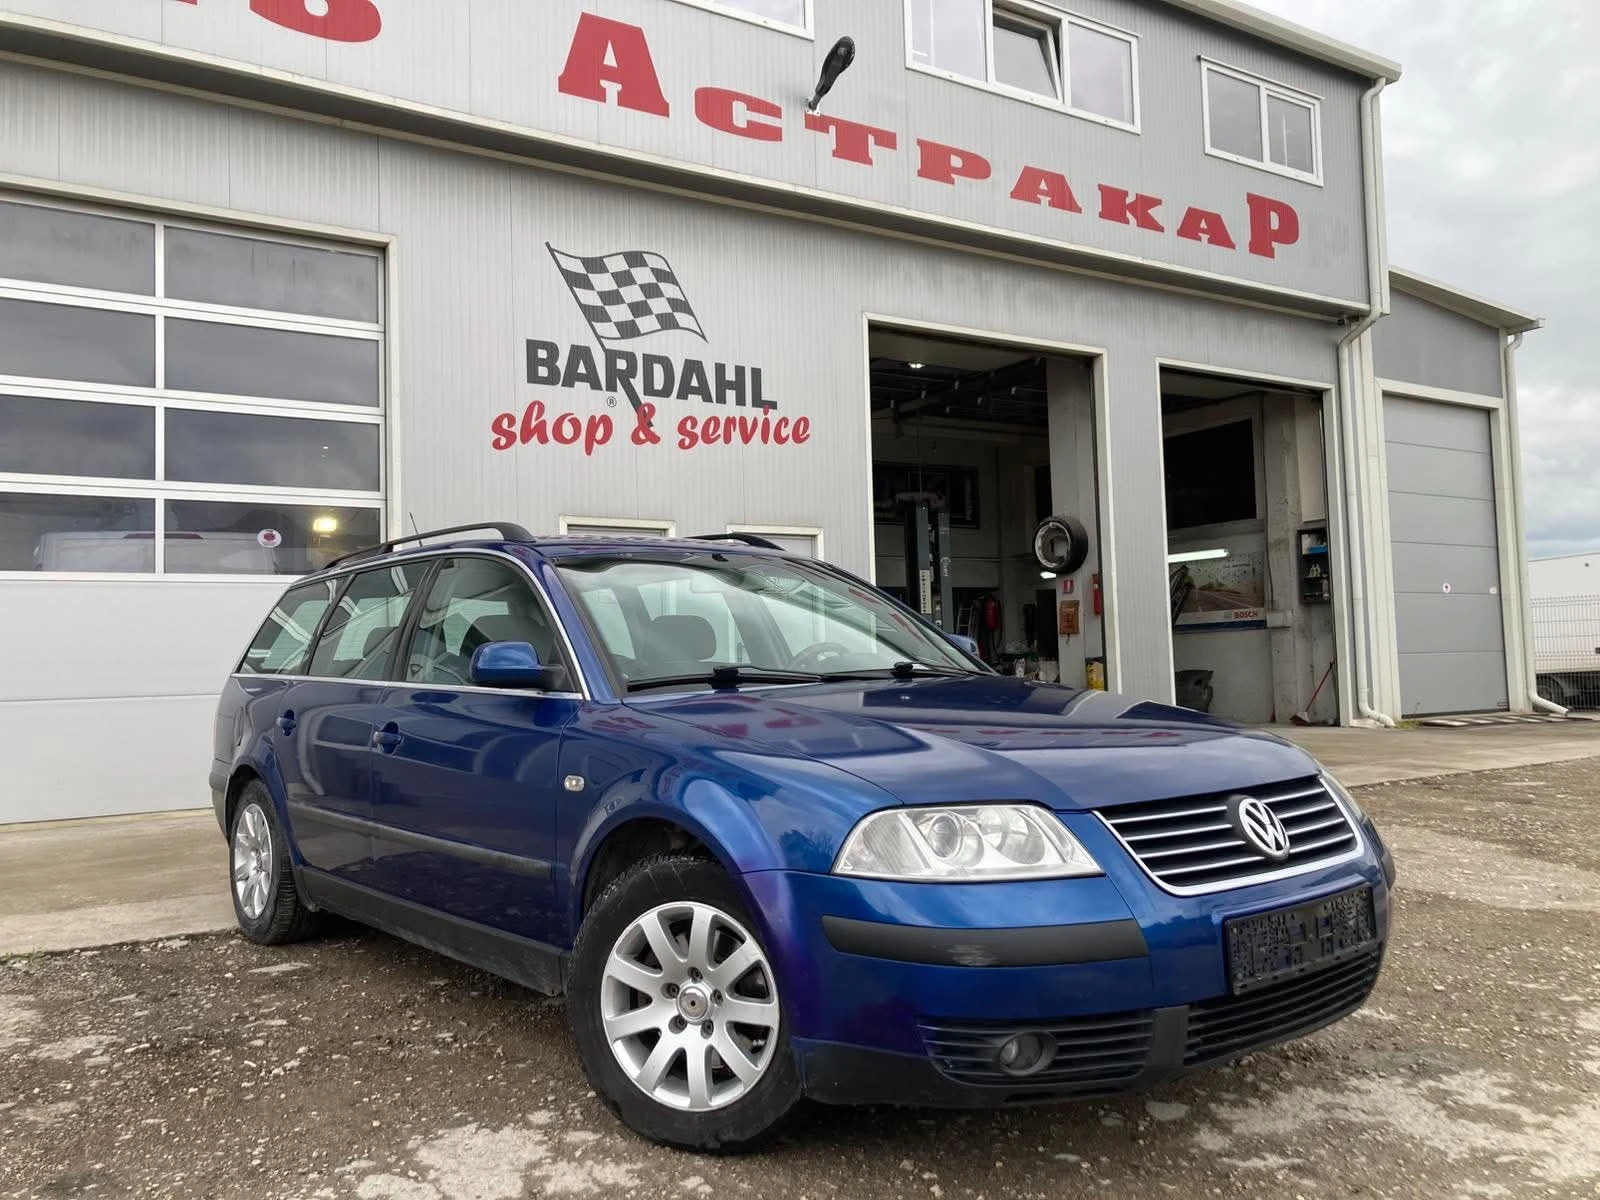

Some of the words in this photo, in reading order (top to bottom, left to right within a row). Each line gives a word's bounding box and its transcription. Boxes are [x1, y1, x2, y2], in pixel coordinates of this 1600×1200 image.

[525, 338, 778, 412] BARDAHL
[491, 400, 613, 456] shop
[630, 402, 661, 446] &
[676, 404, 811, 450] service
[1233, 610, 1258, 619] BOSCH
